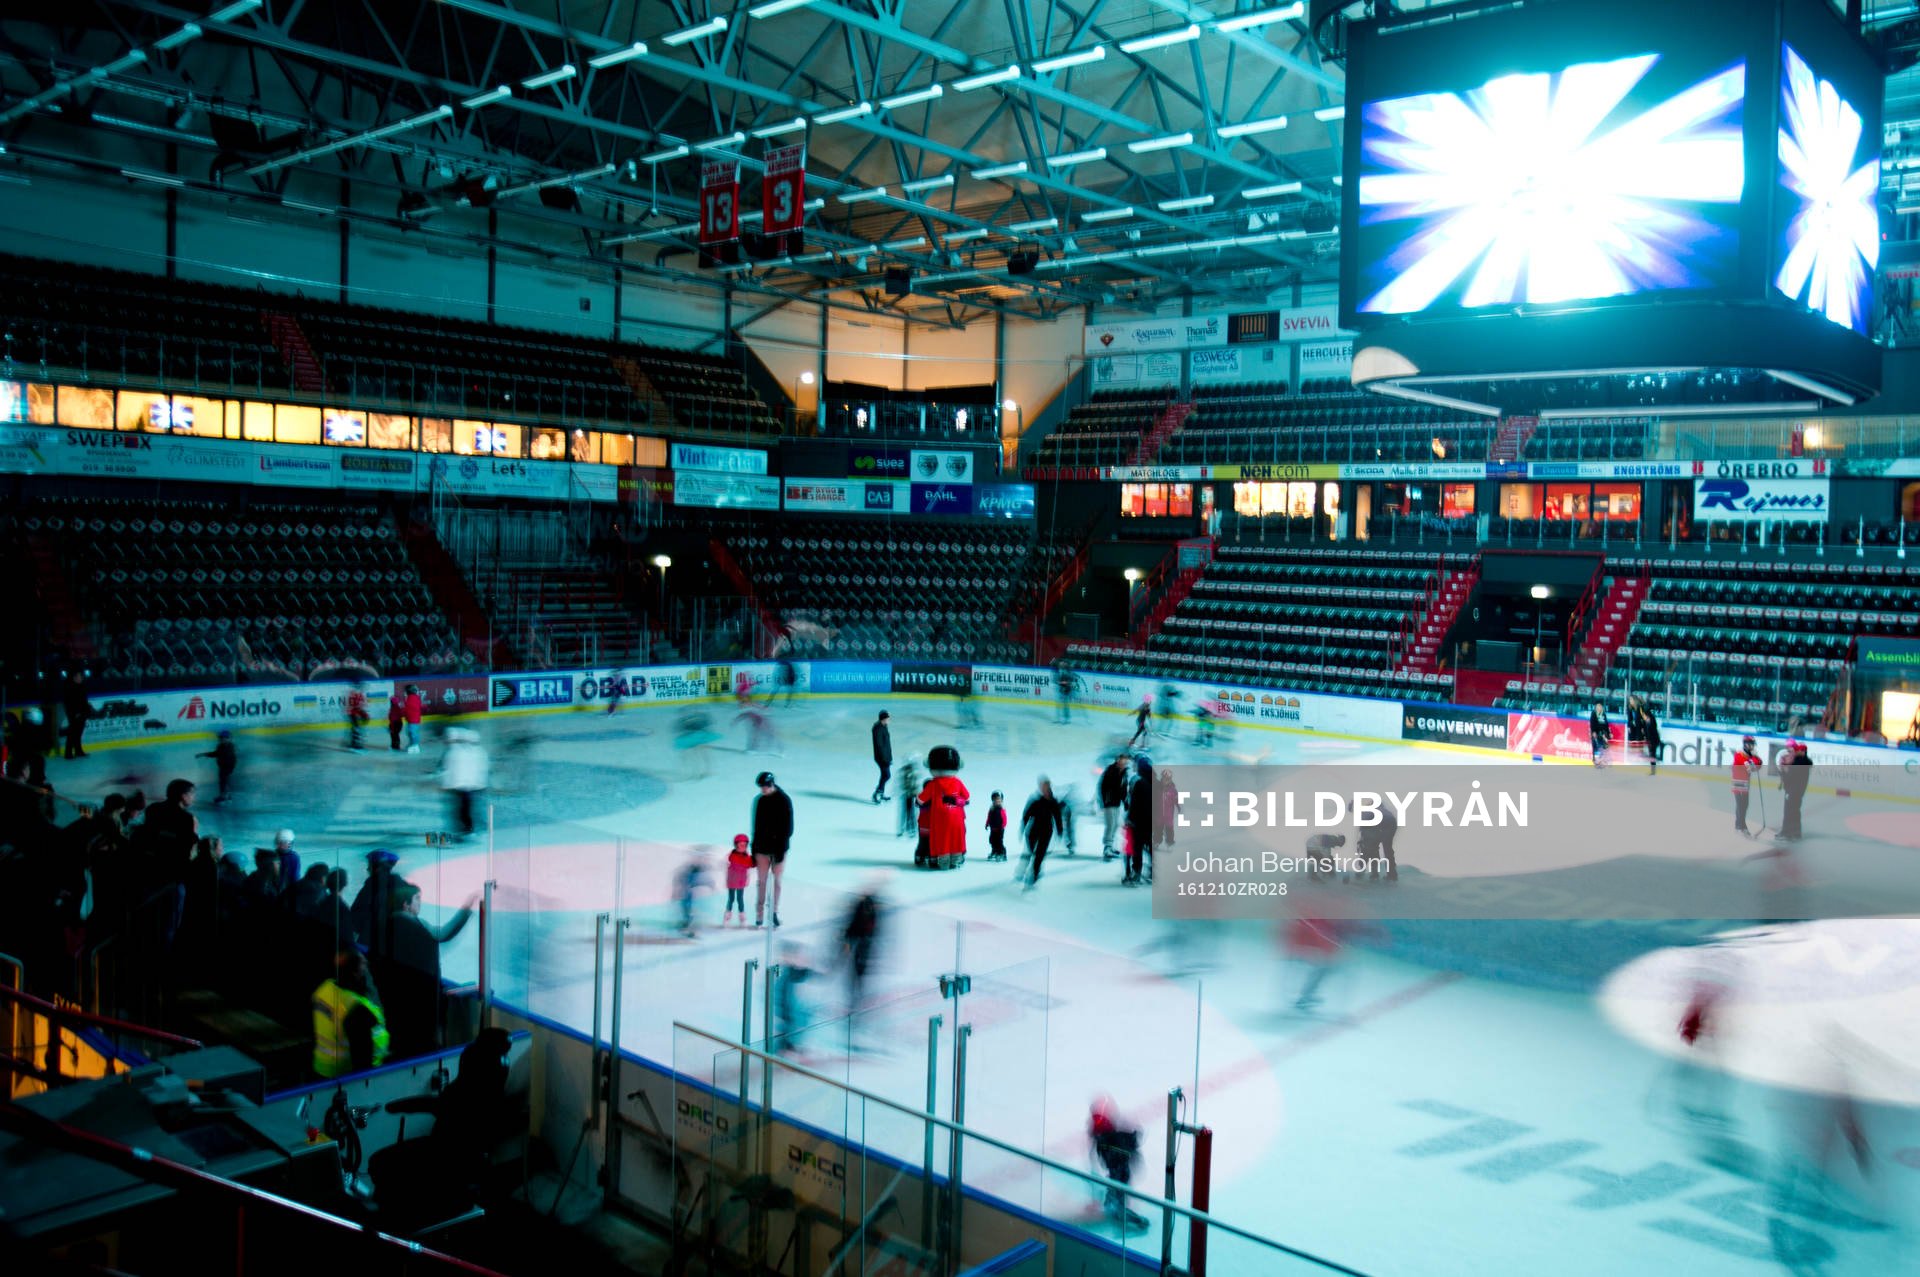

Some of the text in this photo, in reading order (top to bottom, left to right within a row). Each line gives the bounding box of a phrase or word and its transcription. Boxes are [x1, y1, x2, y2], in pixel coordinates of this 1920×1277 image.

[774, 180, 793, 223] 3
[706, 192, 733, 235] 13
[1283, 316, 1330, 331] SVEVIA
[1186, 326, 1218, 338] Thomas
[1302, 346, 1353, 360] HERCULES
[266, 458, 331, 472] Lambertsson
[491, 459, 527, 476] Let's
[1613, 464, 1681, 476] ENGSTRÖMS
[1717, 459, 1799, 479] ÖREBRO
[1131, 469, 1180, 479] MATCHLOGE
[925, 489, 957, 502] DAHL
[979, 494, 1021, 511] KPMG
[974, 671, 1013, 686] OFFICIELL
[1015, 673, 1050, 687] PARTNER
[519, 679, 569, 698] BRL
[211, 699, 282, 719] Nolato
[1261, 707, 1300, 721] EKSJÖHUS
[1417, 716, 1506, 739] CONVENTUM
